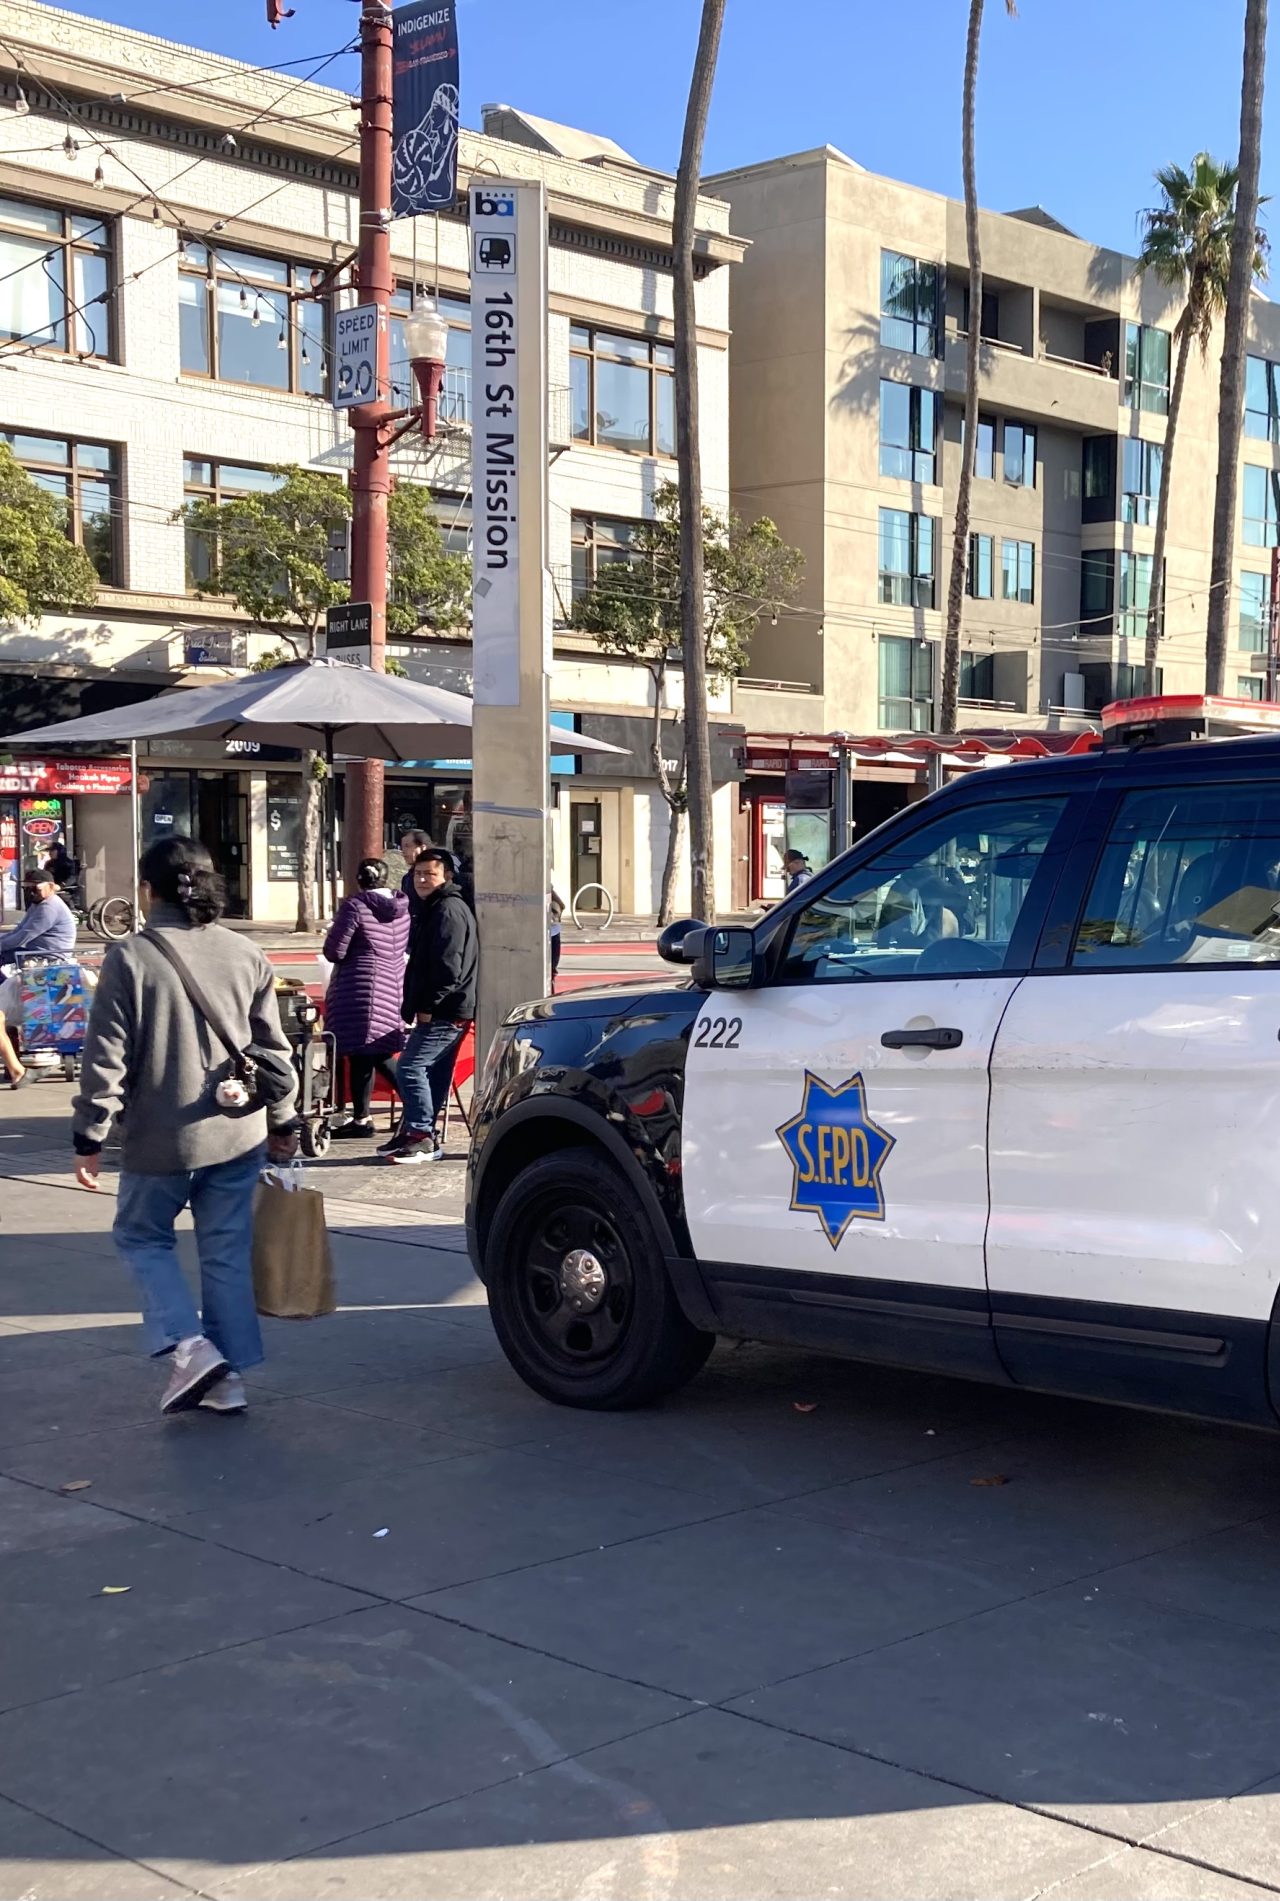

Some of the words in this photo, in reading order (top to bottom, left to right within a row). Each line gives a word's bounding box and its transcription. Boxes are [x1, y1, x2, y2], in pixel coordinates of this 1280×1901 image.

[398, 8, 450, 36] INDIGENIZE
[338, 315, 374, 335] SPEED
[484, 292, 516, 366] 16th
[342, 338, 369, 356] LIMIT
[338, 360, 373, 400] 20
[485, 384, 514, 417] St
[486, 433, 516, 569] Mission
[329, 620, 349, 633] RIGHT
[350, 618, 369, 631] LANE
[226, 740, 260, 752] 2009
[694, 1017, 743, 1048] 222
